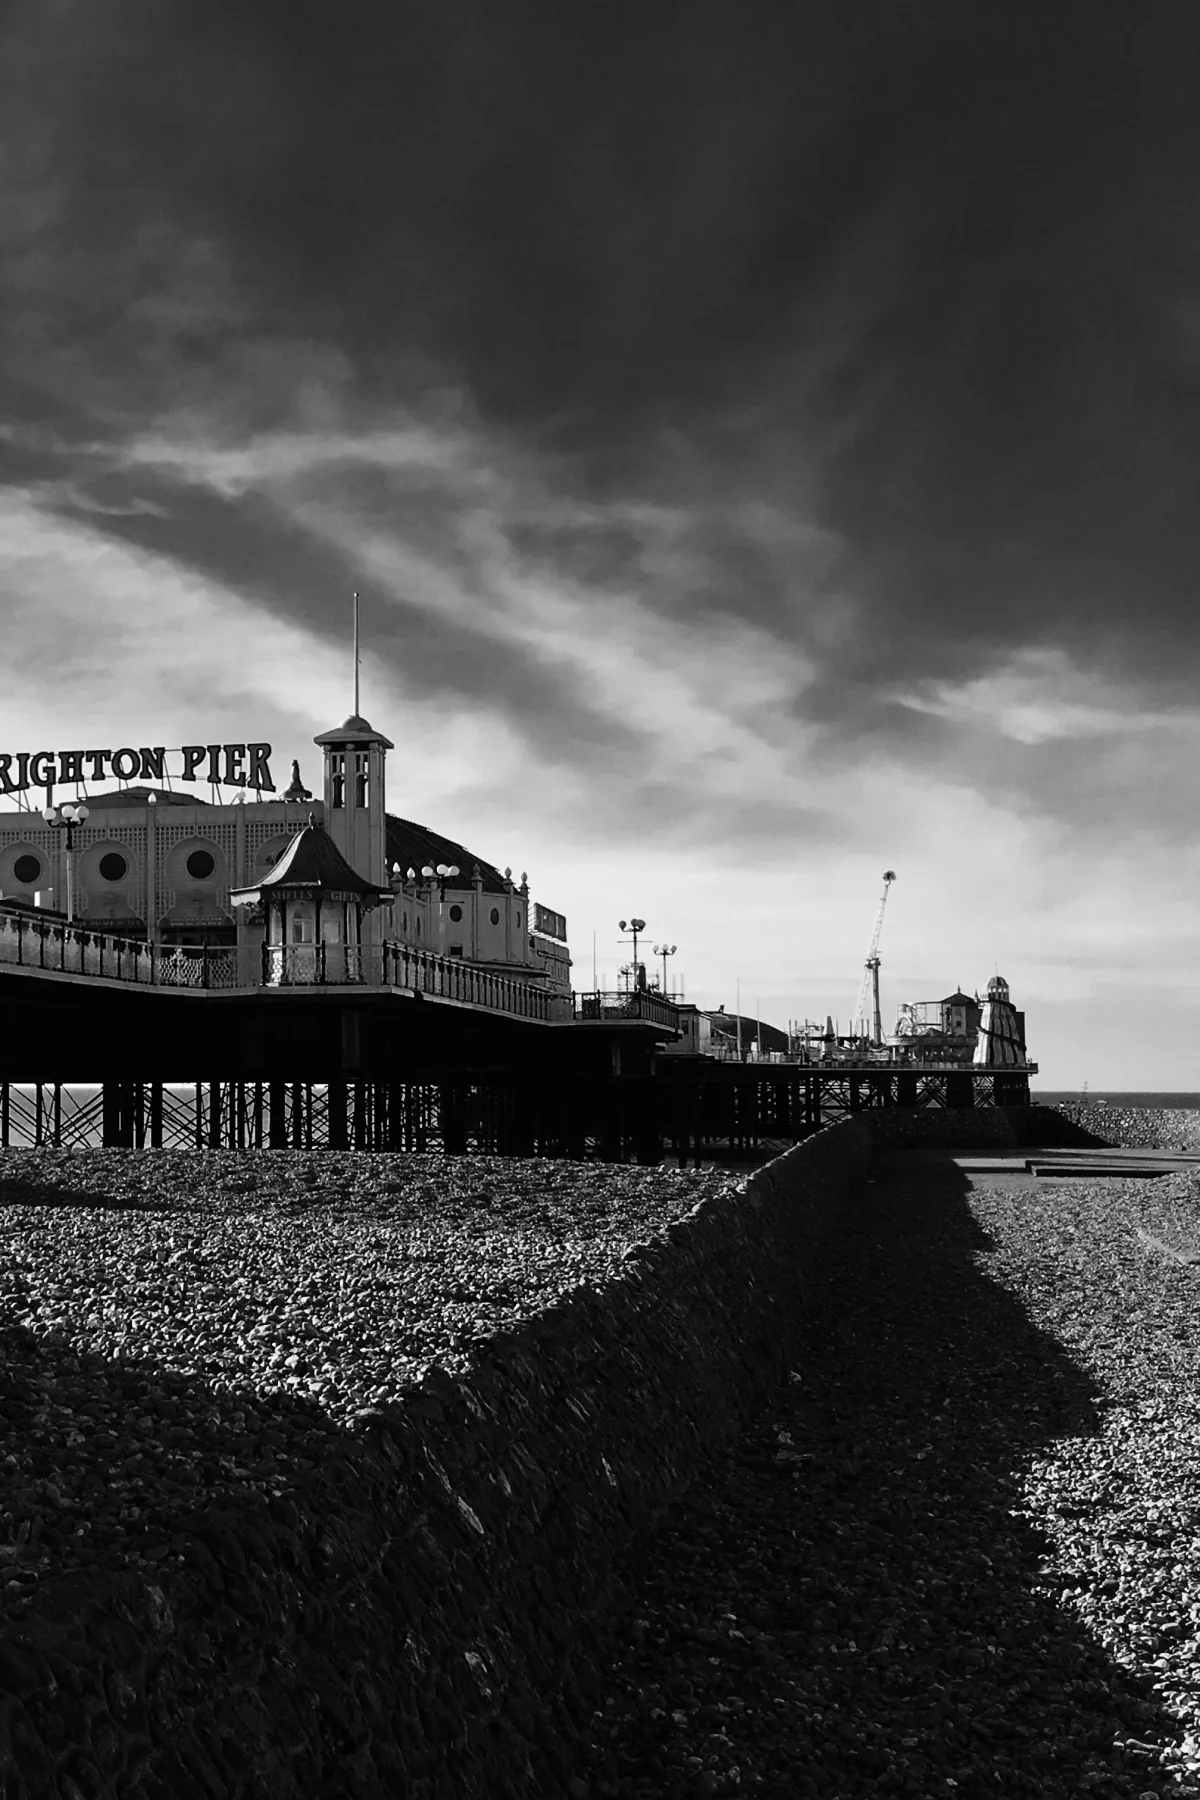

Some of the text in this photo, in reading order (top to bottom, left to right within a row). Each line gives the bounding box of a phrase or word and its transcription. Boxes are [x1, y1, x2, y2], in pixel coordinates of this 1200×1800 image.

[181, 743, 276, 792] PIER
[271, 889, 313, 900] SHELLS
[330, 890, 361, 902] GIFTS
